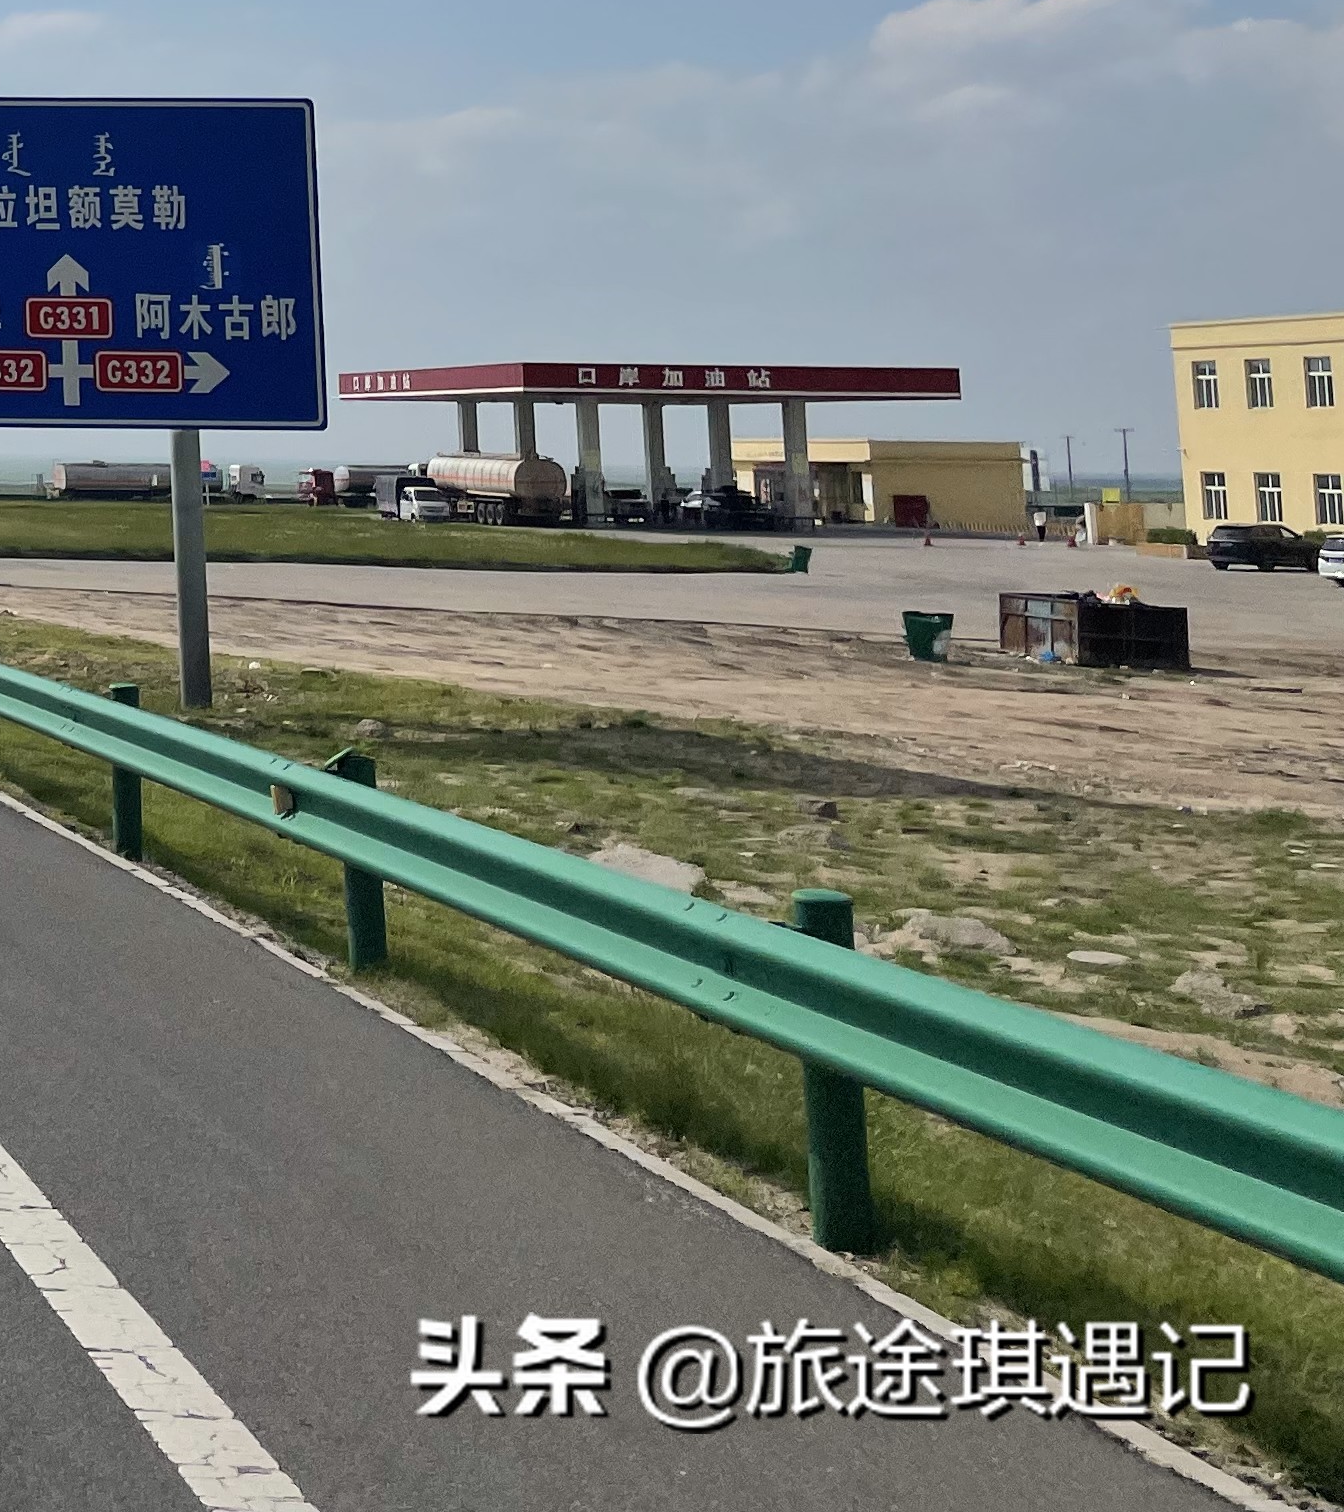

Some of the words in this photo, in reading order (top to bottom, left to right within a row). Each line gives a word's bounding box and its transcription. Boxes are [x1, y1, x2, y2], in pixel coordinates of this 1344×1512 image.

[39, 305, 101, 331] G331
[135, 294, 297, 340] 阿木古郎
[106, 359, 172, 385] G332
